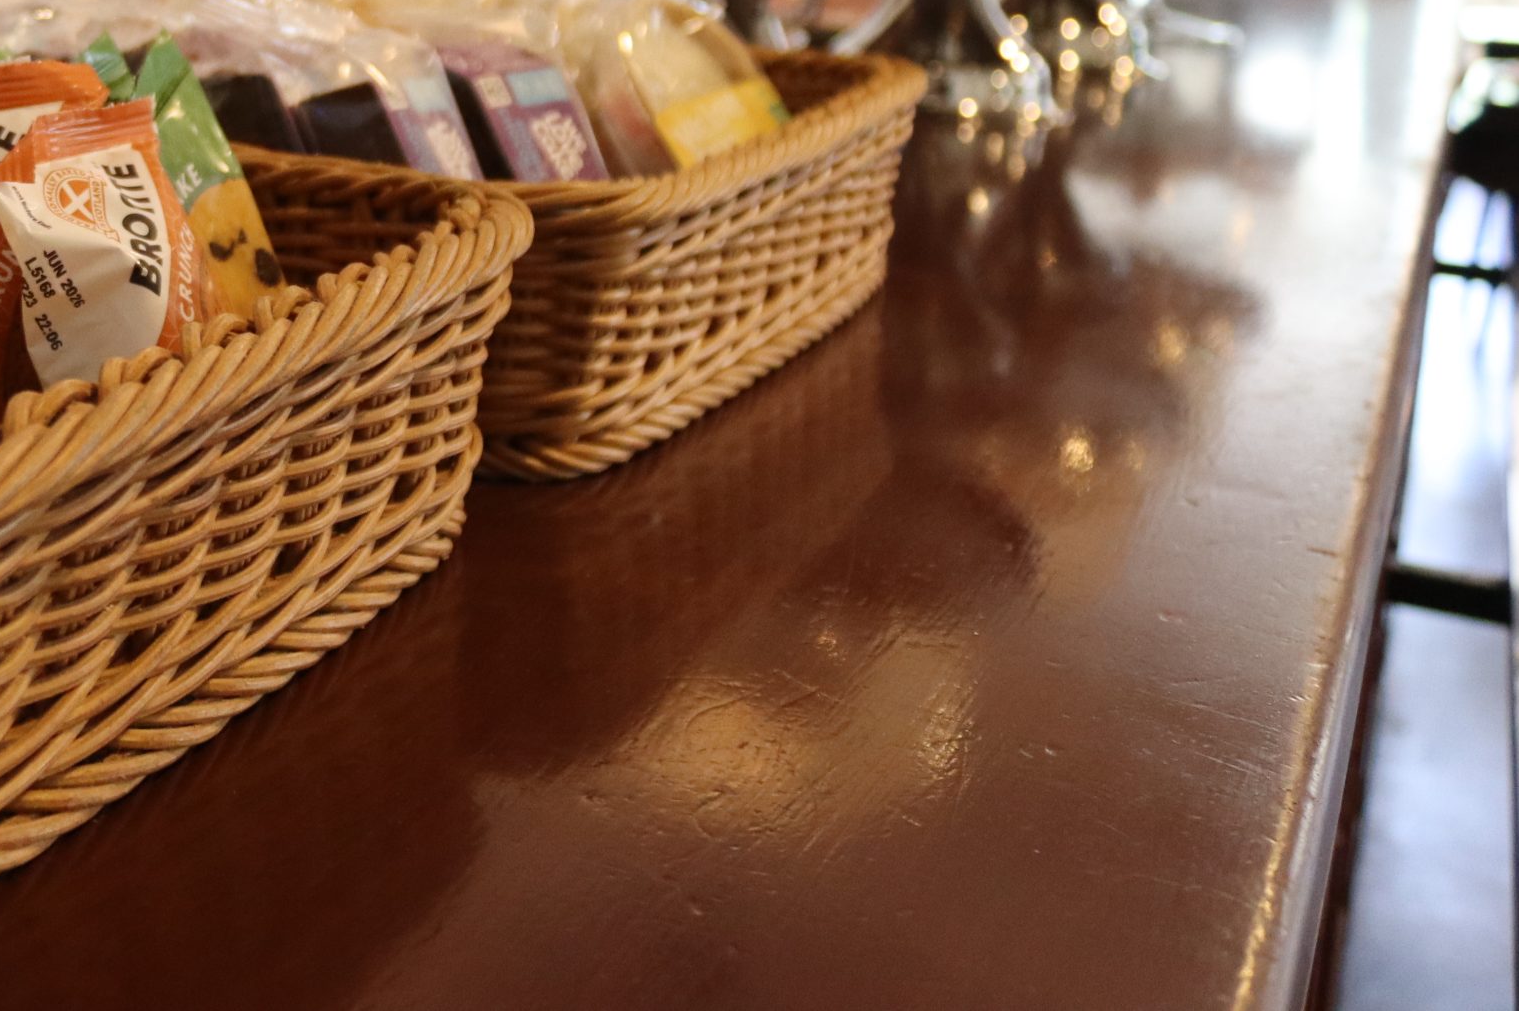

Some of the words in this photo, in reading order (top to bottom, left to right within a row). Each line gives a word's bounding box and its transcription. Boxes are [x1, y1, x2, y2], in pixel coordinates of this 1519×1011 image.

[25, 256, 57, 299] L5168
[44, 249, 67, 279] JUN
[60, 278, 86, 309] 2026
[35, 313, 64, 351] 22:06
